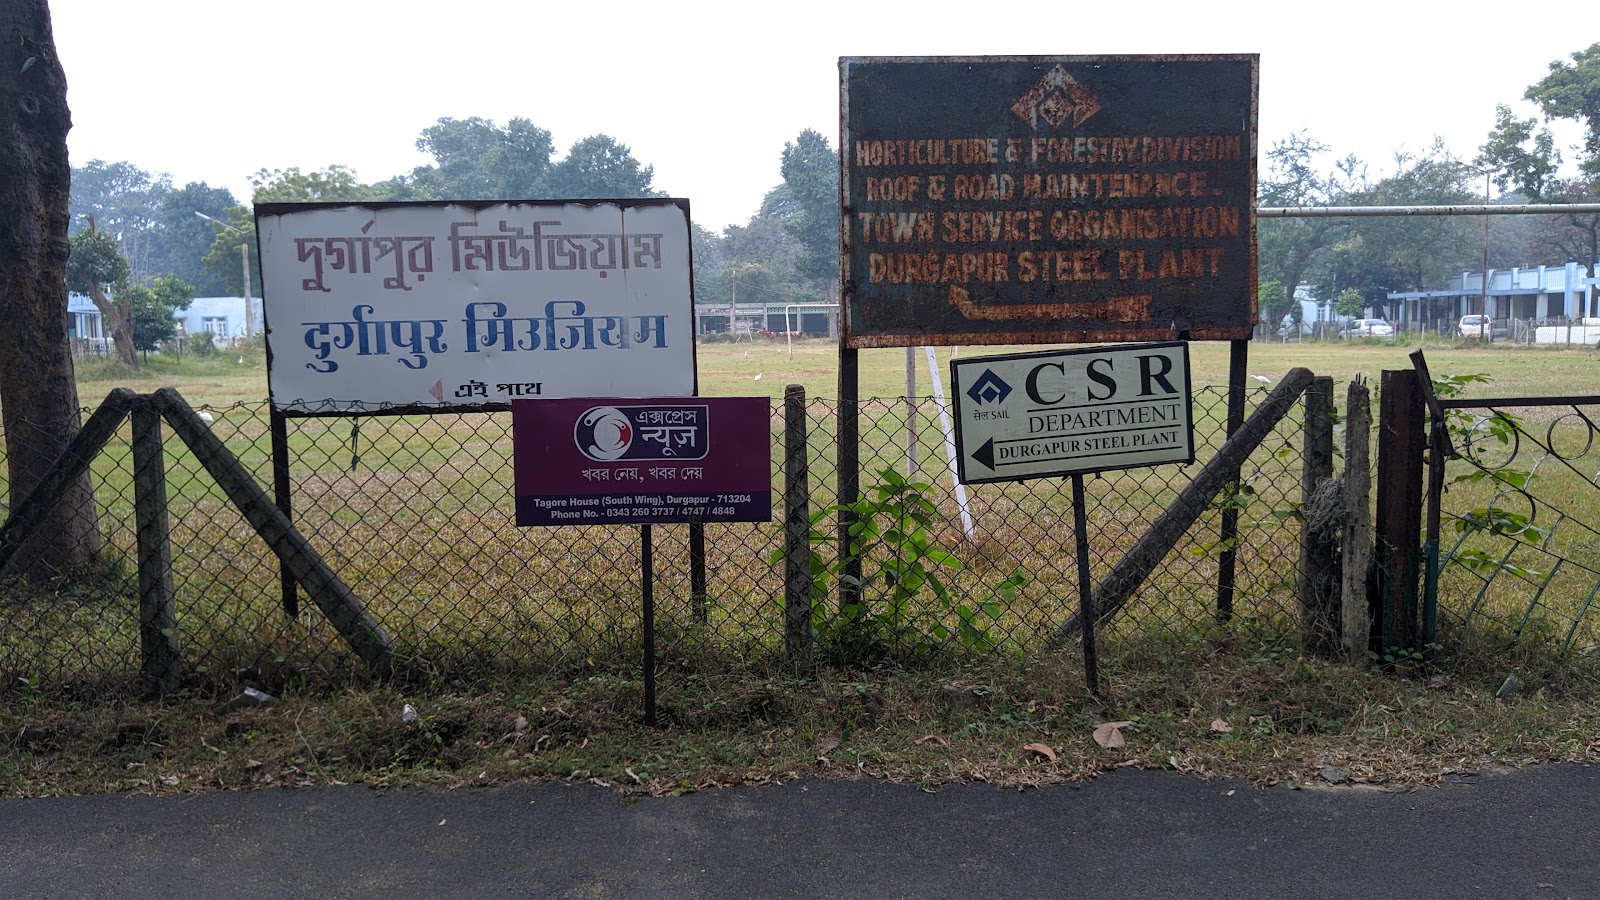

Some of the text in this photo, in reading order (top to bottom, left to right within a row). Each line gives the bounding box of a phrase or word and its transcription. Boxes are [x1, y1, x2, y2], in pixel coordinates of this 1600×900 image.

[856, 138, 998, 166] HORTICULTURE
[1005, 136, 1021, 164] &
[867, 175, 920, 201] ROOF
[926, 174, 945, 201] &
[954, 173, 1014, 200] ROAD
[859, 206, 1239, 243] TOWN SERVICE ORGANISATION
[294, 220, 435, 292] দুর্গাপুর
[869, 248, 1225, 284] DURGAPUR STEEL PLANT
[301, 304, 448, 373] दुर्गापुर
[455, 380, 488, 397] এই
[991, 410, 1010, 420] SAIL
[1028, 404, 1181, 433] DEPARTMENT
[999, 431, 1179, 460] DURGAPUR STEEL PLANT
[581, 467, 610, 482] খবর
[648, 466, 677, 480] খবর
[534, 498, 567, 509] Tagore
[569, 497, 599, 507] House
[602, 496, 632, 507] (South
[666, 495, 709, 506] Durgapur
[717, 494, 751, 504] 713204
[551, 510, 580, 519] Phone
[583, 509, 599, 518] No.
[607, 508, 630, 517] 0343
[632, 508, 650, 517] 260
[652, 507, 675, 516] 3737
[682, 507, 705, 516] 4747
[712, 506, 735, 515] 4848
